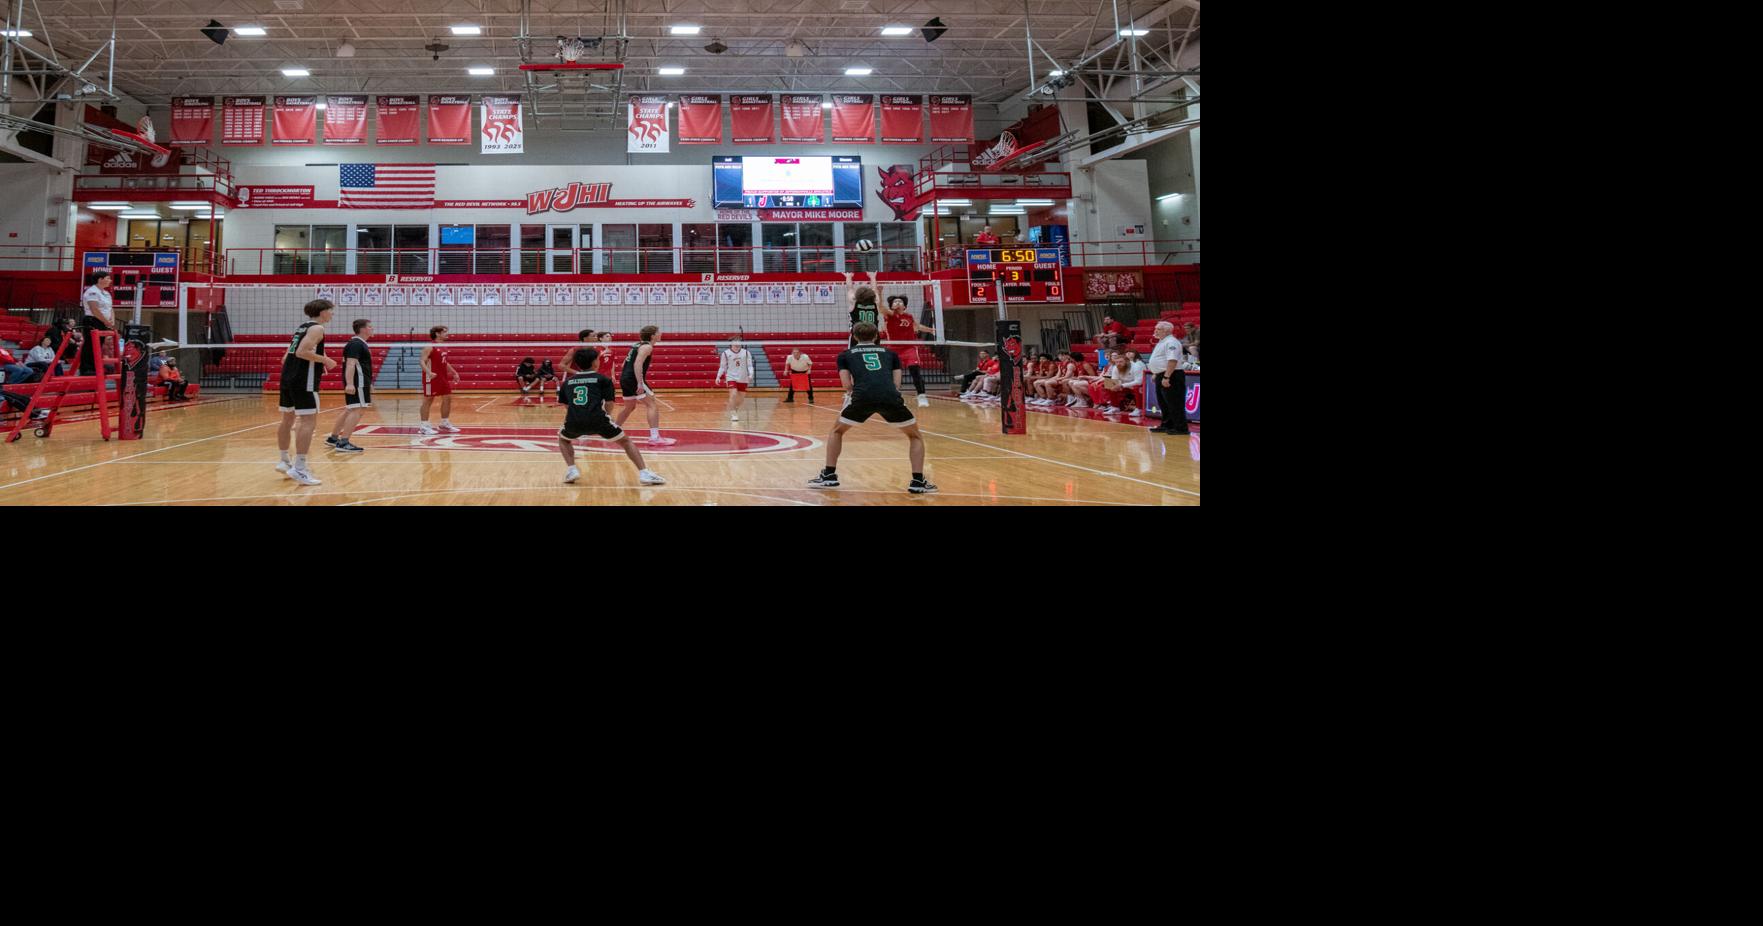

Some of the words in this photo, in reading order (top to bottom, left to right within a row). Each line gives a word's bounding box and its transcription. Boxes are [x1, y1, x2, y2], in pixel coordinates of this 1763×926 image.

[772, 210, 803, 218] MAYOR
[804, 210, 827, 218] MIKE
[828, 210, 860, 218] MOORE
[1002, 250, 1034, 262] 6:50
[1012, 272, 1018, 280] 3
[1054, 270, 1058, 280] 1
[977, 287, 984, 296] 2
[1052, 286, 1058, 296] 0
[859, 310, 875, 323] 10
[862, 353, 882, 370] 5
[573, 386, 588, 406] 3
